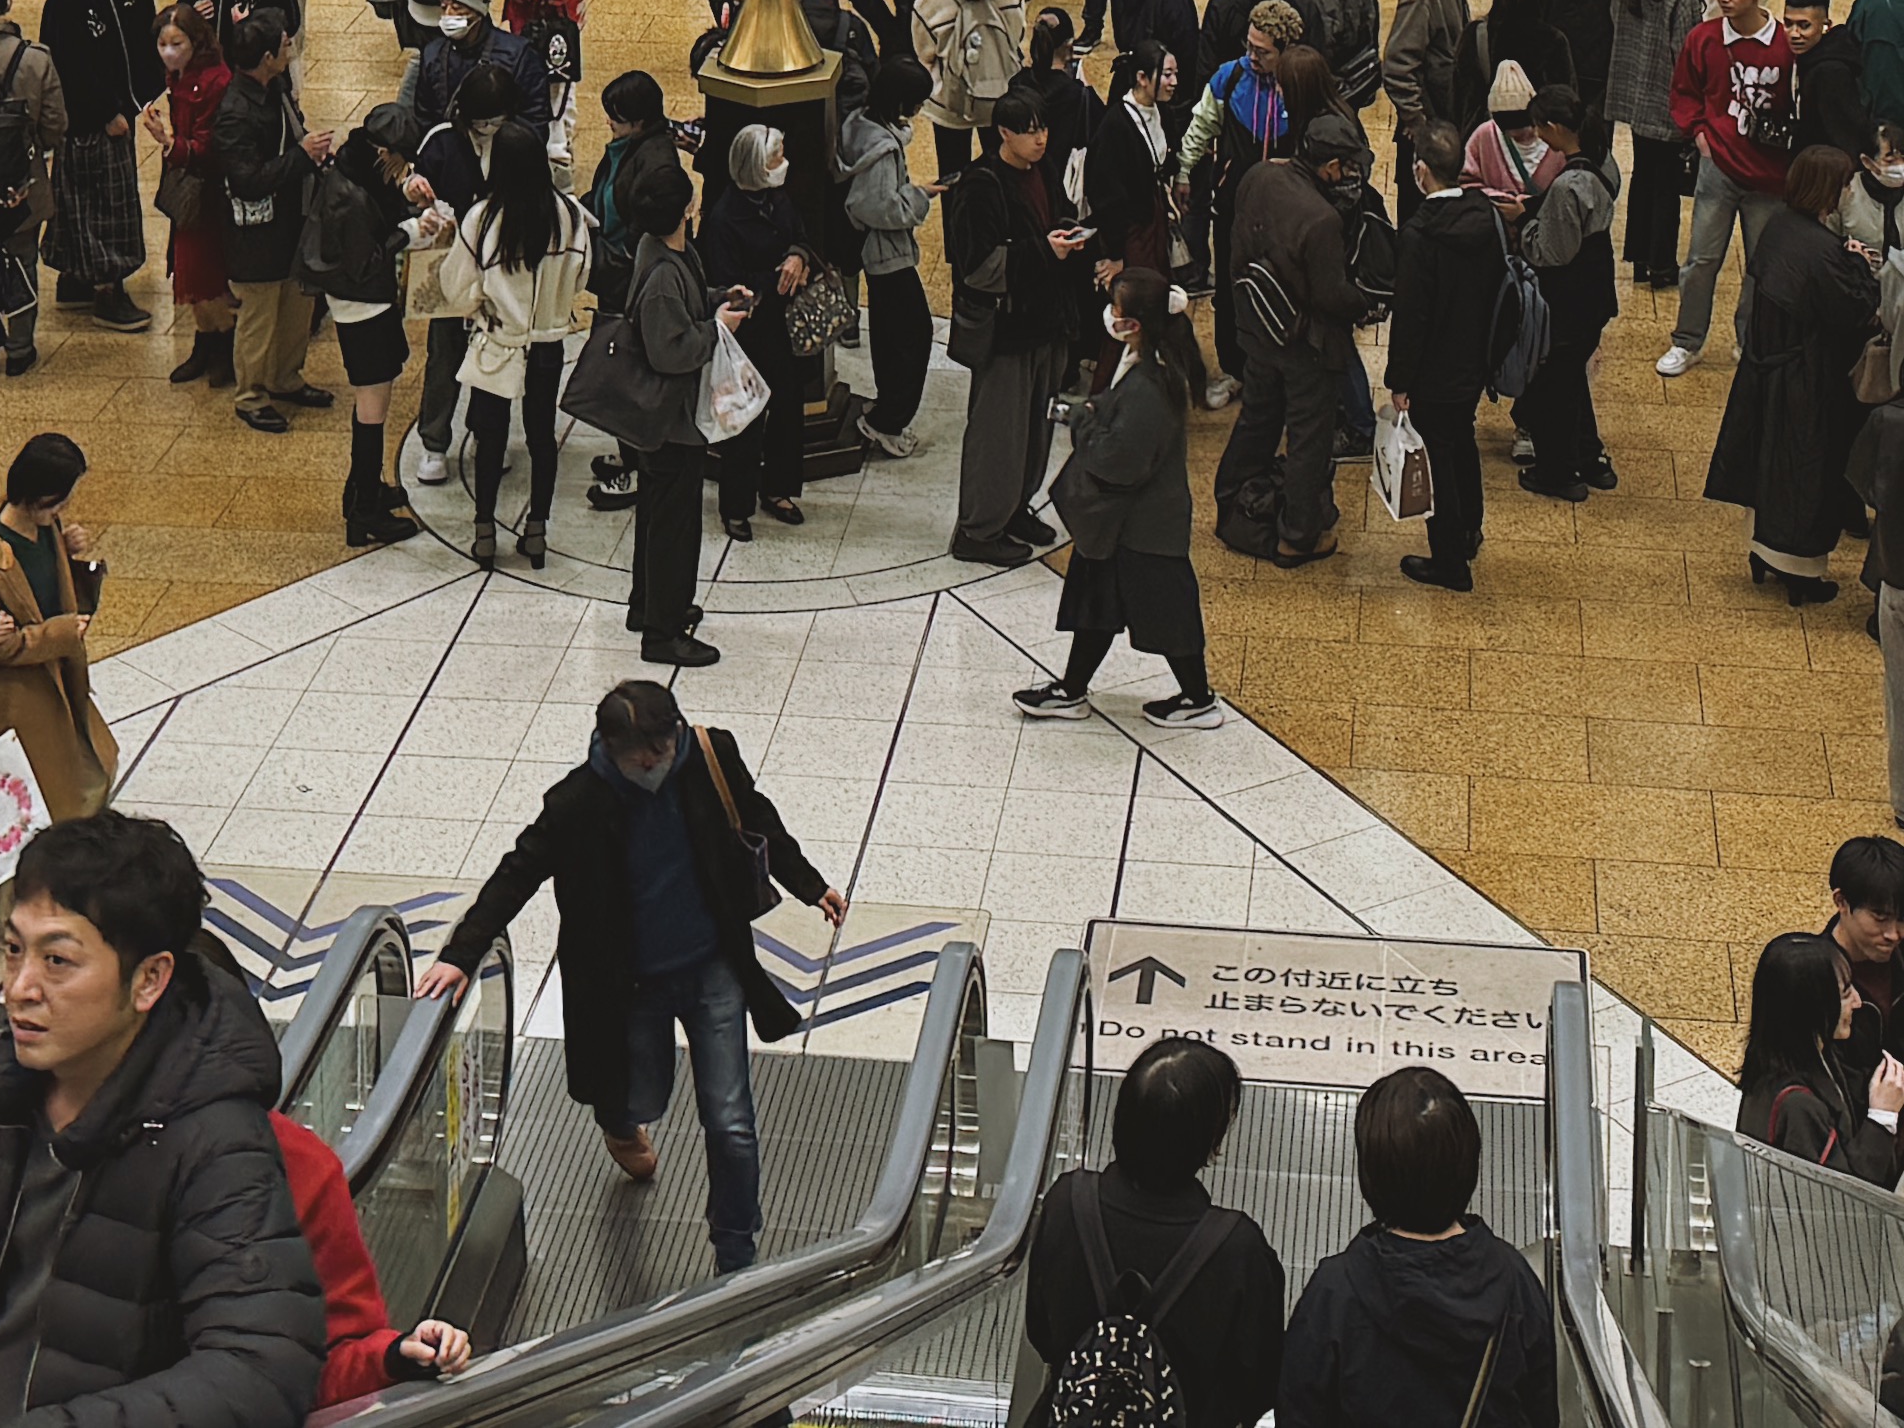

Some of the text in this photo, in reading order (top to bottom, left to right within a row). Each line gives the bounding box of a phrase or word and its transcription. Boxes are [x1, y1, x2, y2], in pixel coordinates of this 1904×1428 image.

[1212, 963, 1460, 997] この付近に立ち
[1098, 1019, 1146, 1041] Do
[1230, 1032, 1333, 1052] stand
[1346, 1036, 1377, 1055] in
[1392, 1040, 1457, 1060] this
